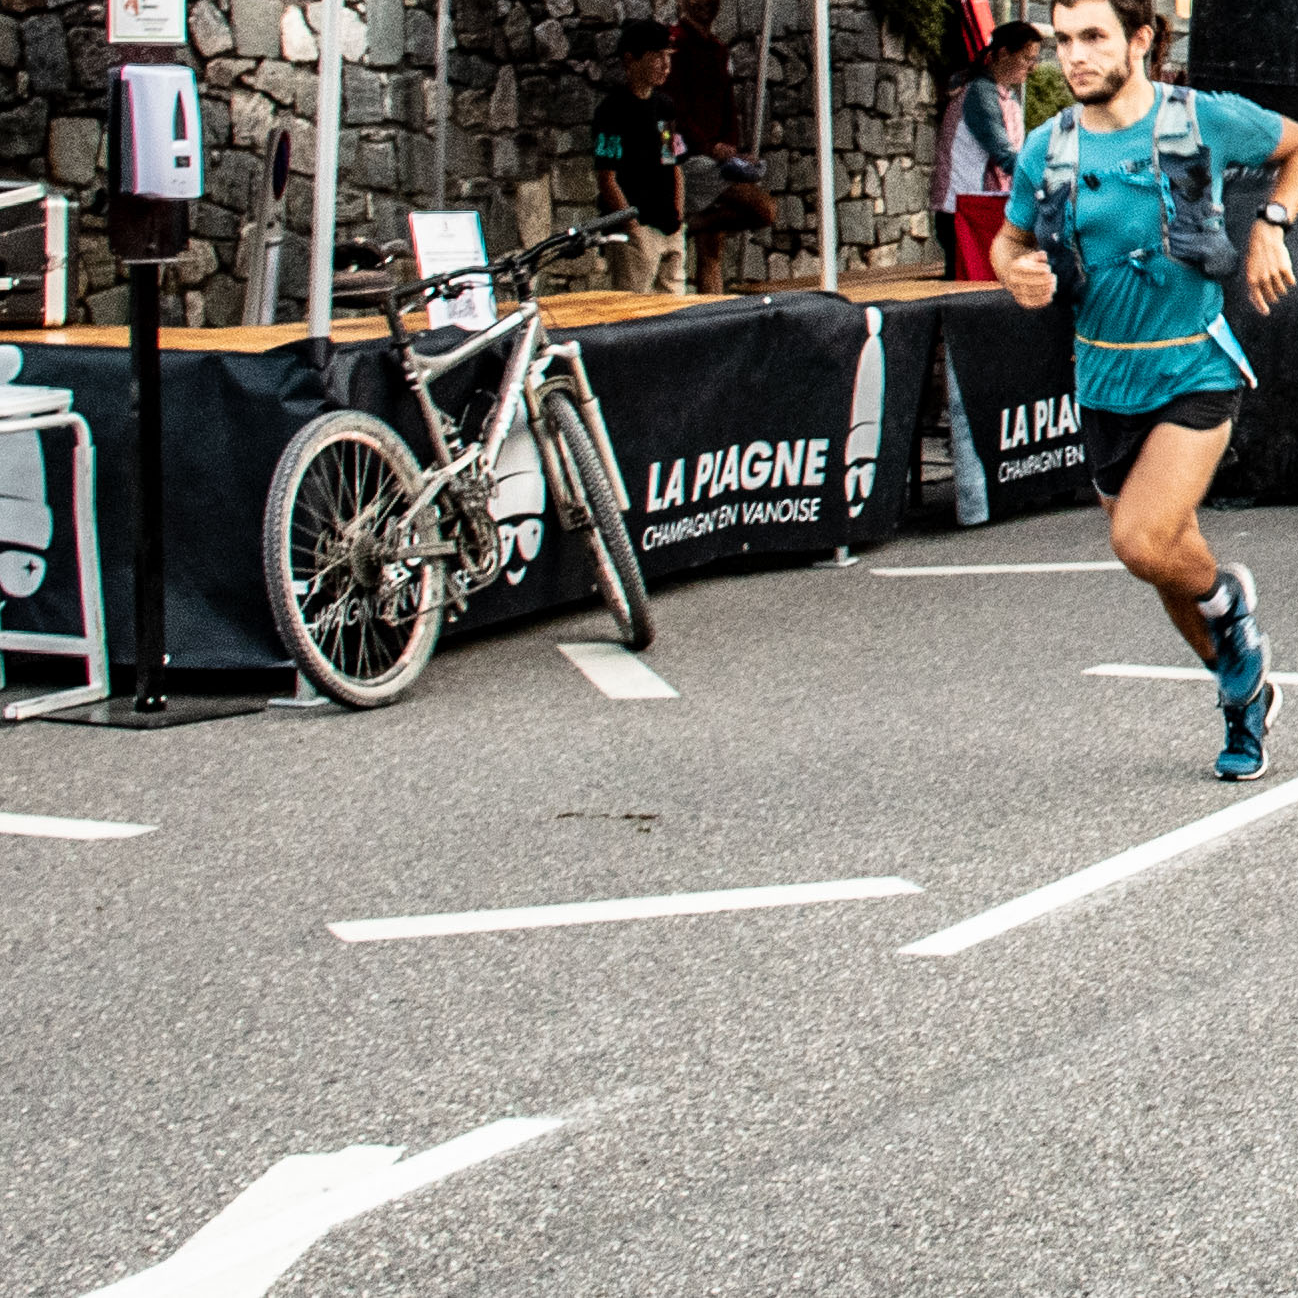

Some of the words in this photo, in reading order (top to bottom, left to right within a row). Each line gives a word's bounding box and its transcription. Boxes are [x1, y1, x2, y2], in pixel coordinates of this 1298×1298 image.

[1000, 404, 1030, 452] LA
[1034, 393, 1082, 442] PLA
[645, 457, 687, 514] LA
[690, 437, 830, 503] PLAGNE
[742, 496, 823, 526] VANOISE
